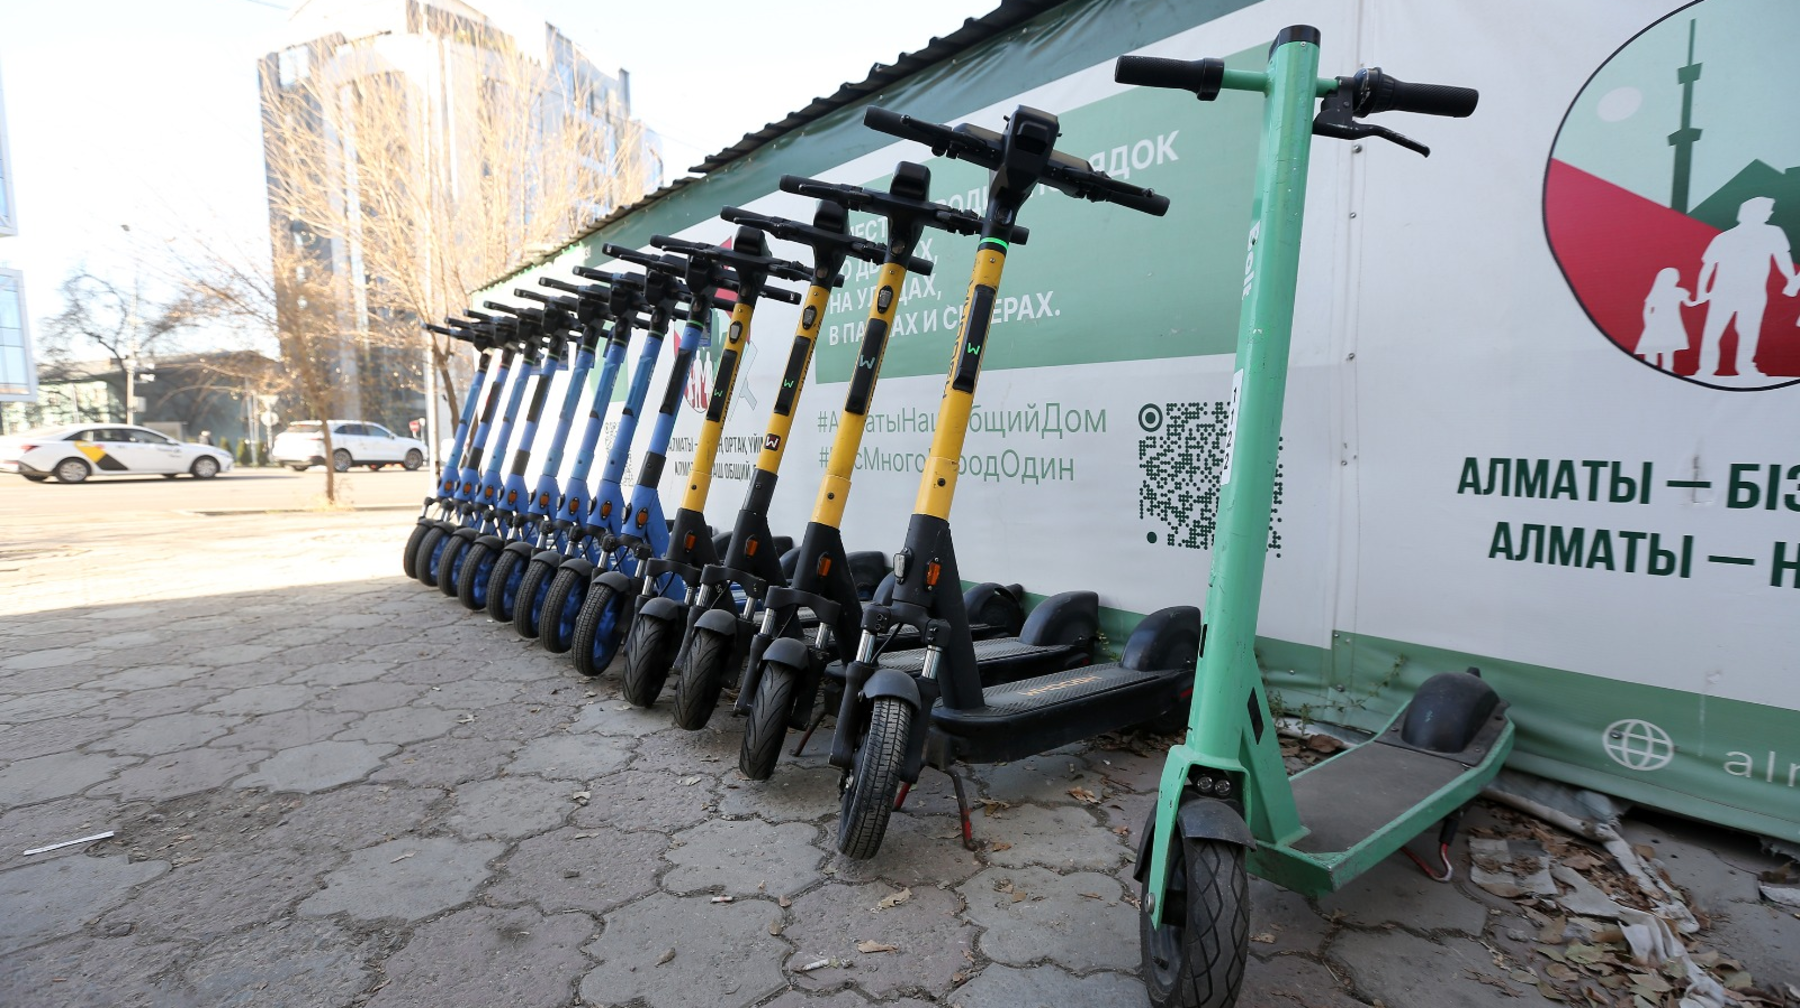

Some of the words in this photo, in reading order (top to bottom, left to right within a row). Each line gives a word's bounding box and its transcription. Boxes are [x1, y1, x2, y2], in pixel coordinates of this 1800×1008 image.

[1082, 130, 1180, 181] ЯДОК
[1242, 220, 1260, 300] Bolt
[829, 291, 853, 314] НА
[829, 325, 839, 346] В
[843, 312, 919, 344] ПААХ
[923, 309, 938, 333] И
[943, 291, 1061, 330] СЕРАХ.
[817, 402, 1107, 439] #АатыНабщийДом
[1457, 457, 1653, 505] АЛМАТЫ
[1488, 522, 1694, 579] АЛМАТЫ
